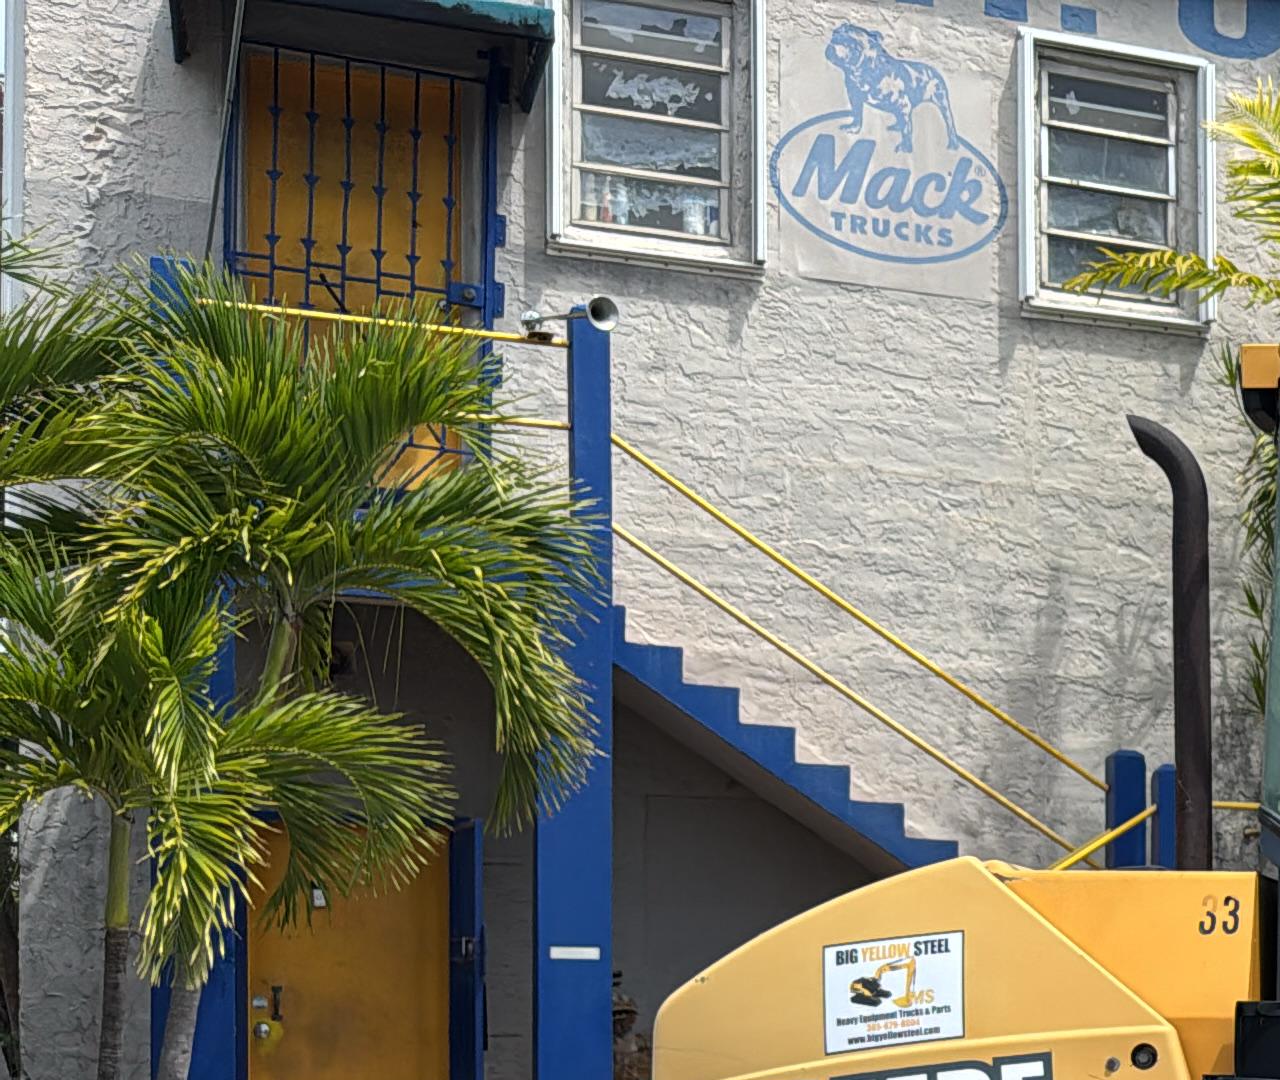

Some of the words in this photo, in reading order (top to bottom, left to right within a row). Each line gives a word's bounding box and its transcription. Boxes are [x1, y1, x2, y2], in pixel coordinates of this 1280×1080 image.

[792, 134, 989, 224] Mack
[831, 211, 953, 247] TRUCKS
[1198, 894, 1240, 935] 33
[835, 949, 858, 966] BIG
[861, 943, 911, 963] YELLOW
[914, 938, 951, 956] STEEL
[836, 1016, 858, 1027] Heavy
[860, 1010, 898, 1024] Equipment
[899, 1007, 923, 1019] Trucks
[932, 1004, 951, 1014] Parts
[848, 1026, 941, 1045] www.bigyellowsteel.com
